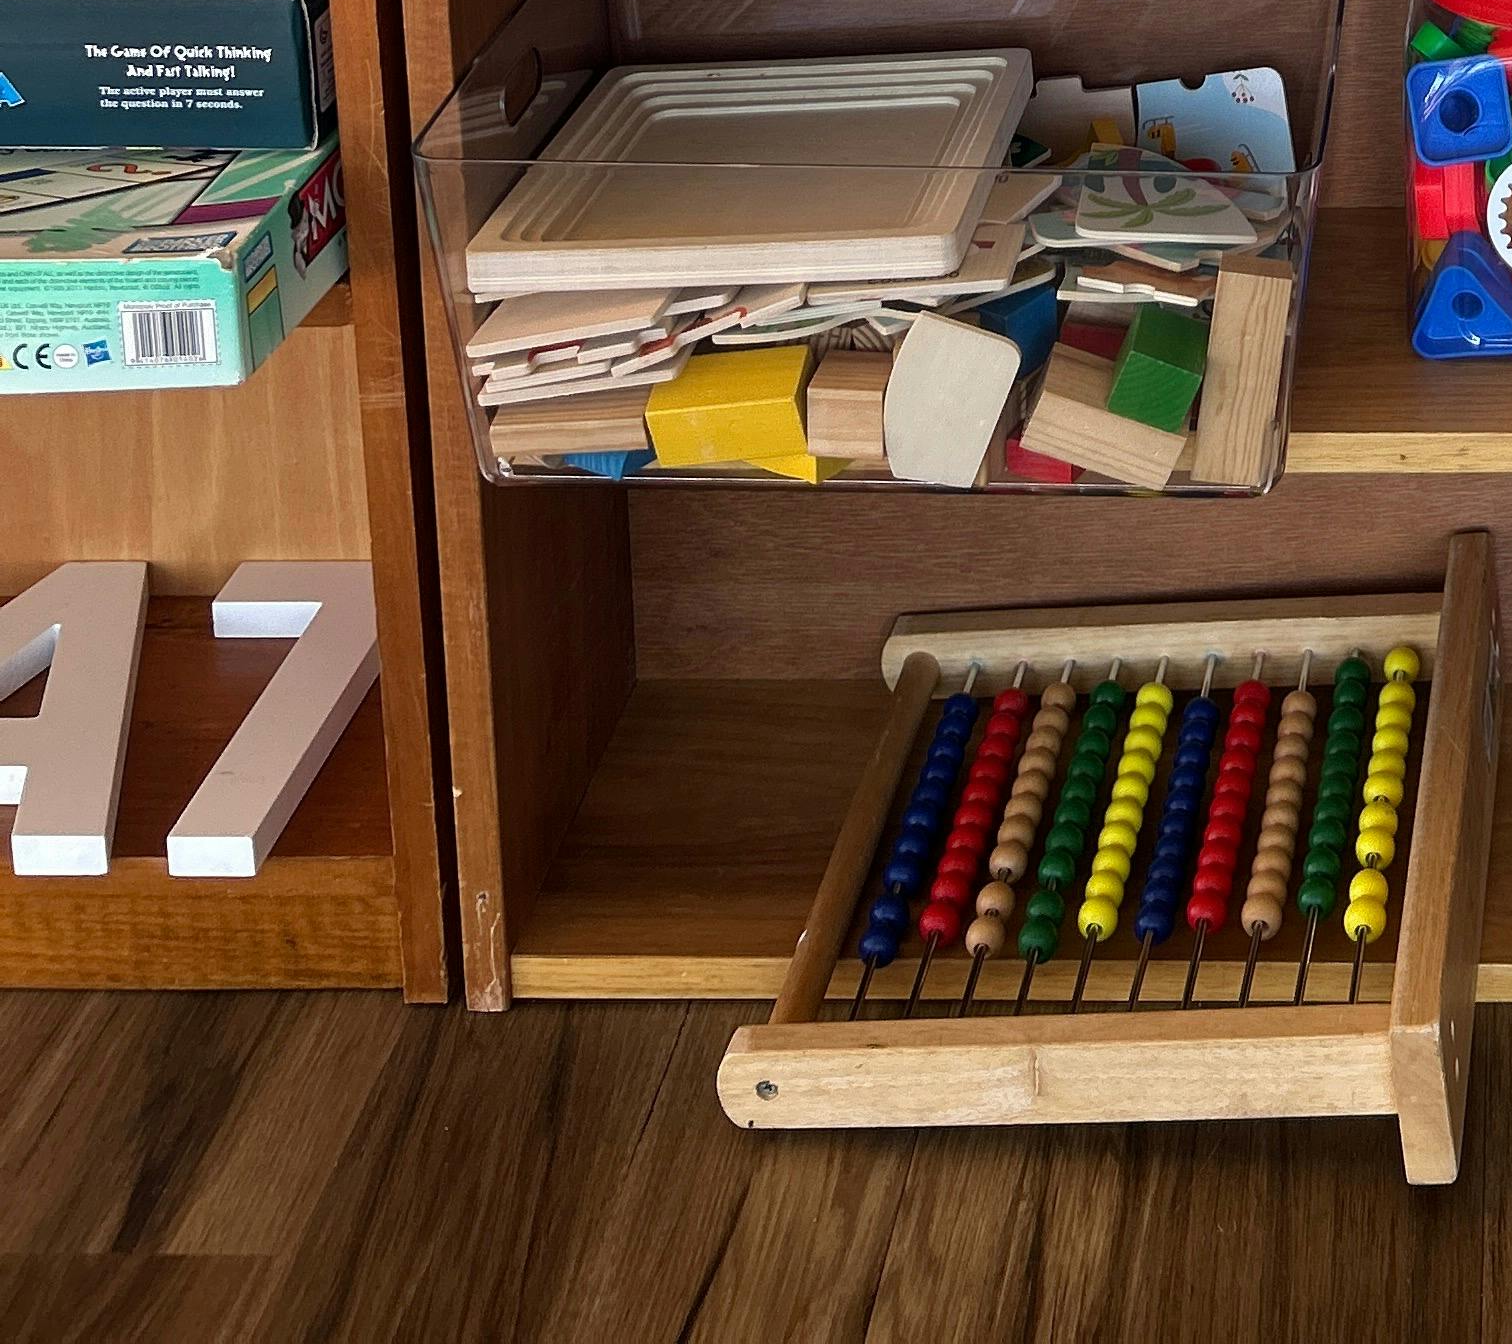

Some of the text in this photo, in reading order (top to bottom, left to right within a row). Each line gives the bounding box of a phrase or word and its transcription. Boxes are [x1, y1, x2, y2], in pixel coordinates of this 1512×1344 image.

[84, 44, 272, 63] The Game Of Quick Thinking
